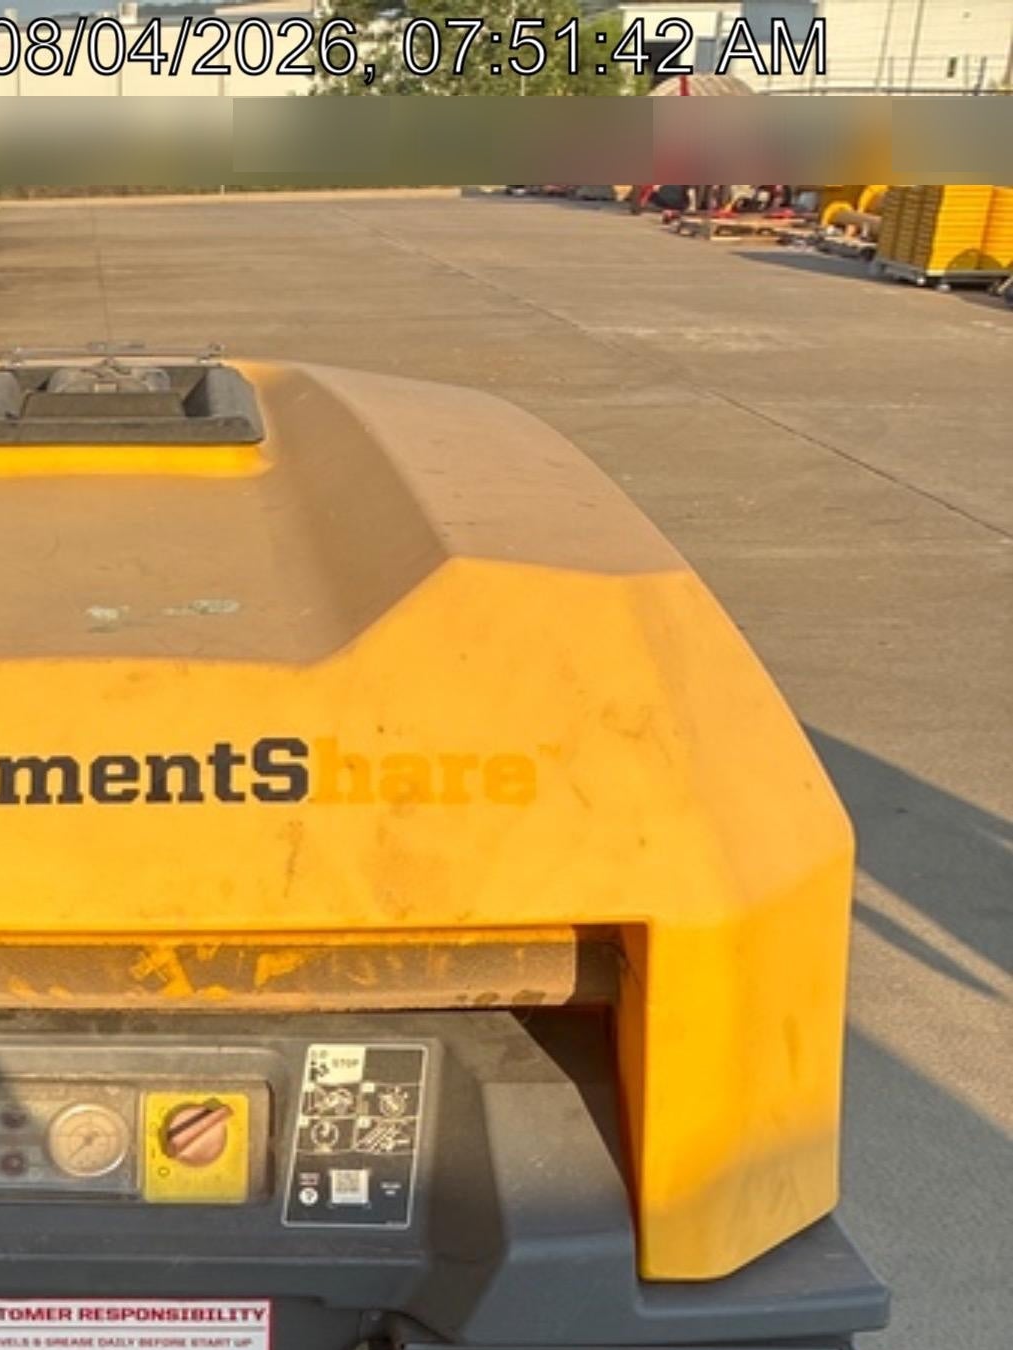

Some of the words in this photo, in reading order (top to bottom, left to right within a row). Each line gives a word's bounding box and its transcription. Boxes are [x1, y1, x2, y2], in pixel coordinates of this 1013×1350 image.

[79, 1307, 267, 1322] RESPONSIBILITY
[98, 1336, 134, 1347] DAILY
[139, 1336, 186, 1347] BEFORE
[190, 1336, 230, 1347] START
